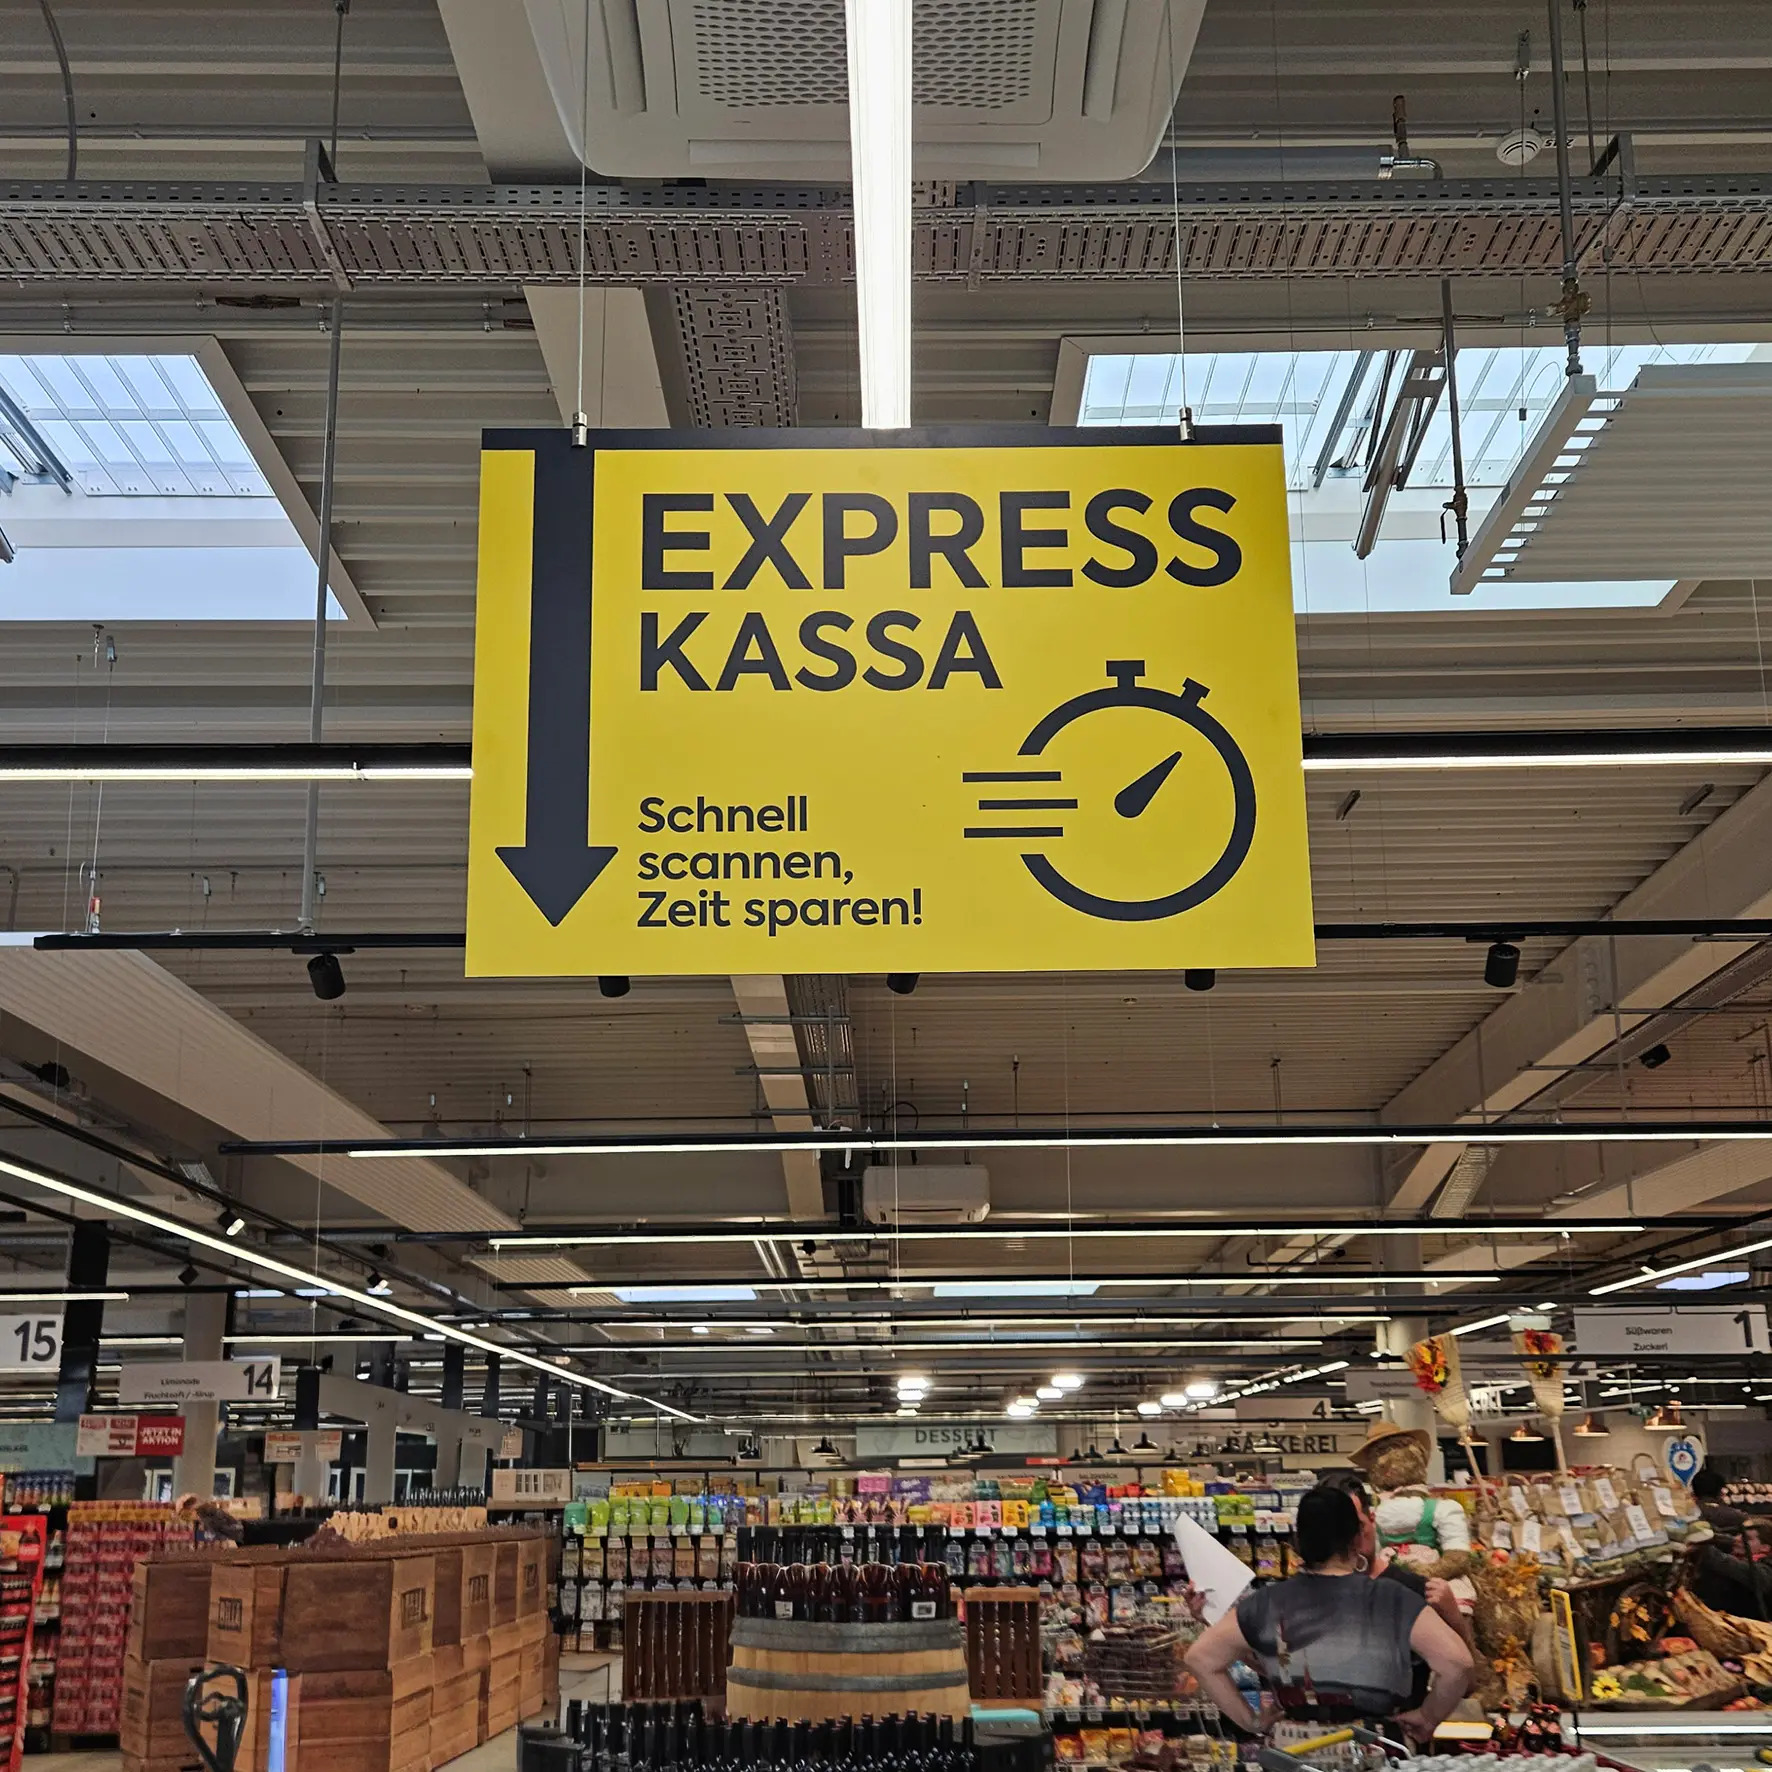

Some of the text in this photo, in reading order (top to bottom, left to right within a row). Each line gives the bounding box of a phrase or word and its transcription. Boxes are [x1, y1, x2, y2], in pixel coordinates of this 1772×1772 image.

[642, 487, 1242, 591] EXPRESS
[640, 609, 1003, 692] KASSA
[637, 795, 808, 832] Schnell
[637, 847, 854, 885] scannen,
[636, 888, 923, 936] Zeit sparen!
[14, 1320, 57, 1362] 15
[1733, 1310, 1753, 1348] 1
[243, 1363, 273, 1395] 14
[1312, 1400, 1328, 1419] 4
[140, 1427, 182, 1437] JETZT IN
[142, 1437, 179, 1446] AKTION
[915, 1428, 998, 1444] DESSERT
[1226, 1432, 1338, 1453] BÄKEREI
